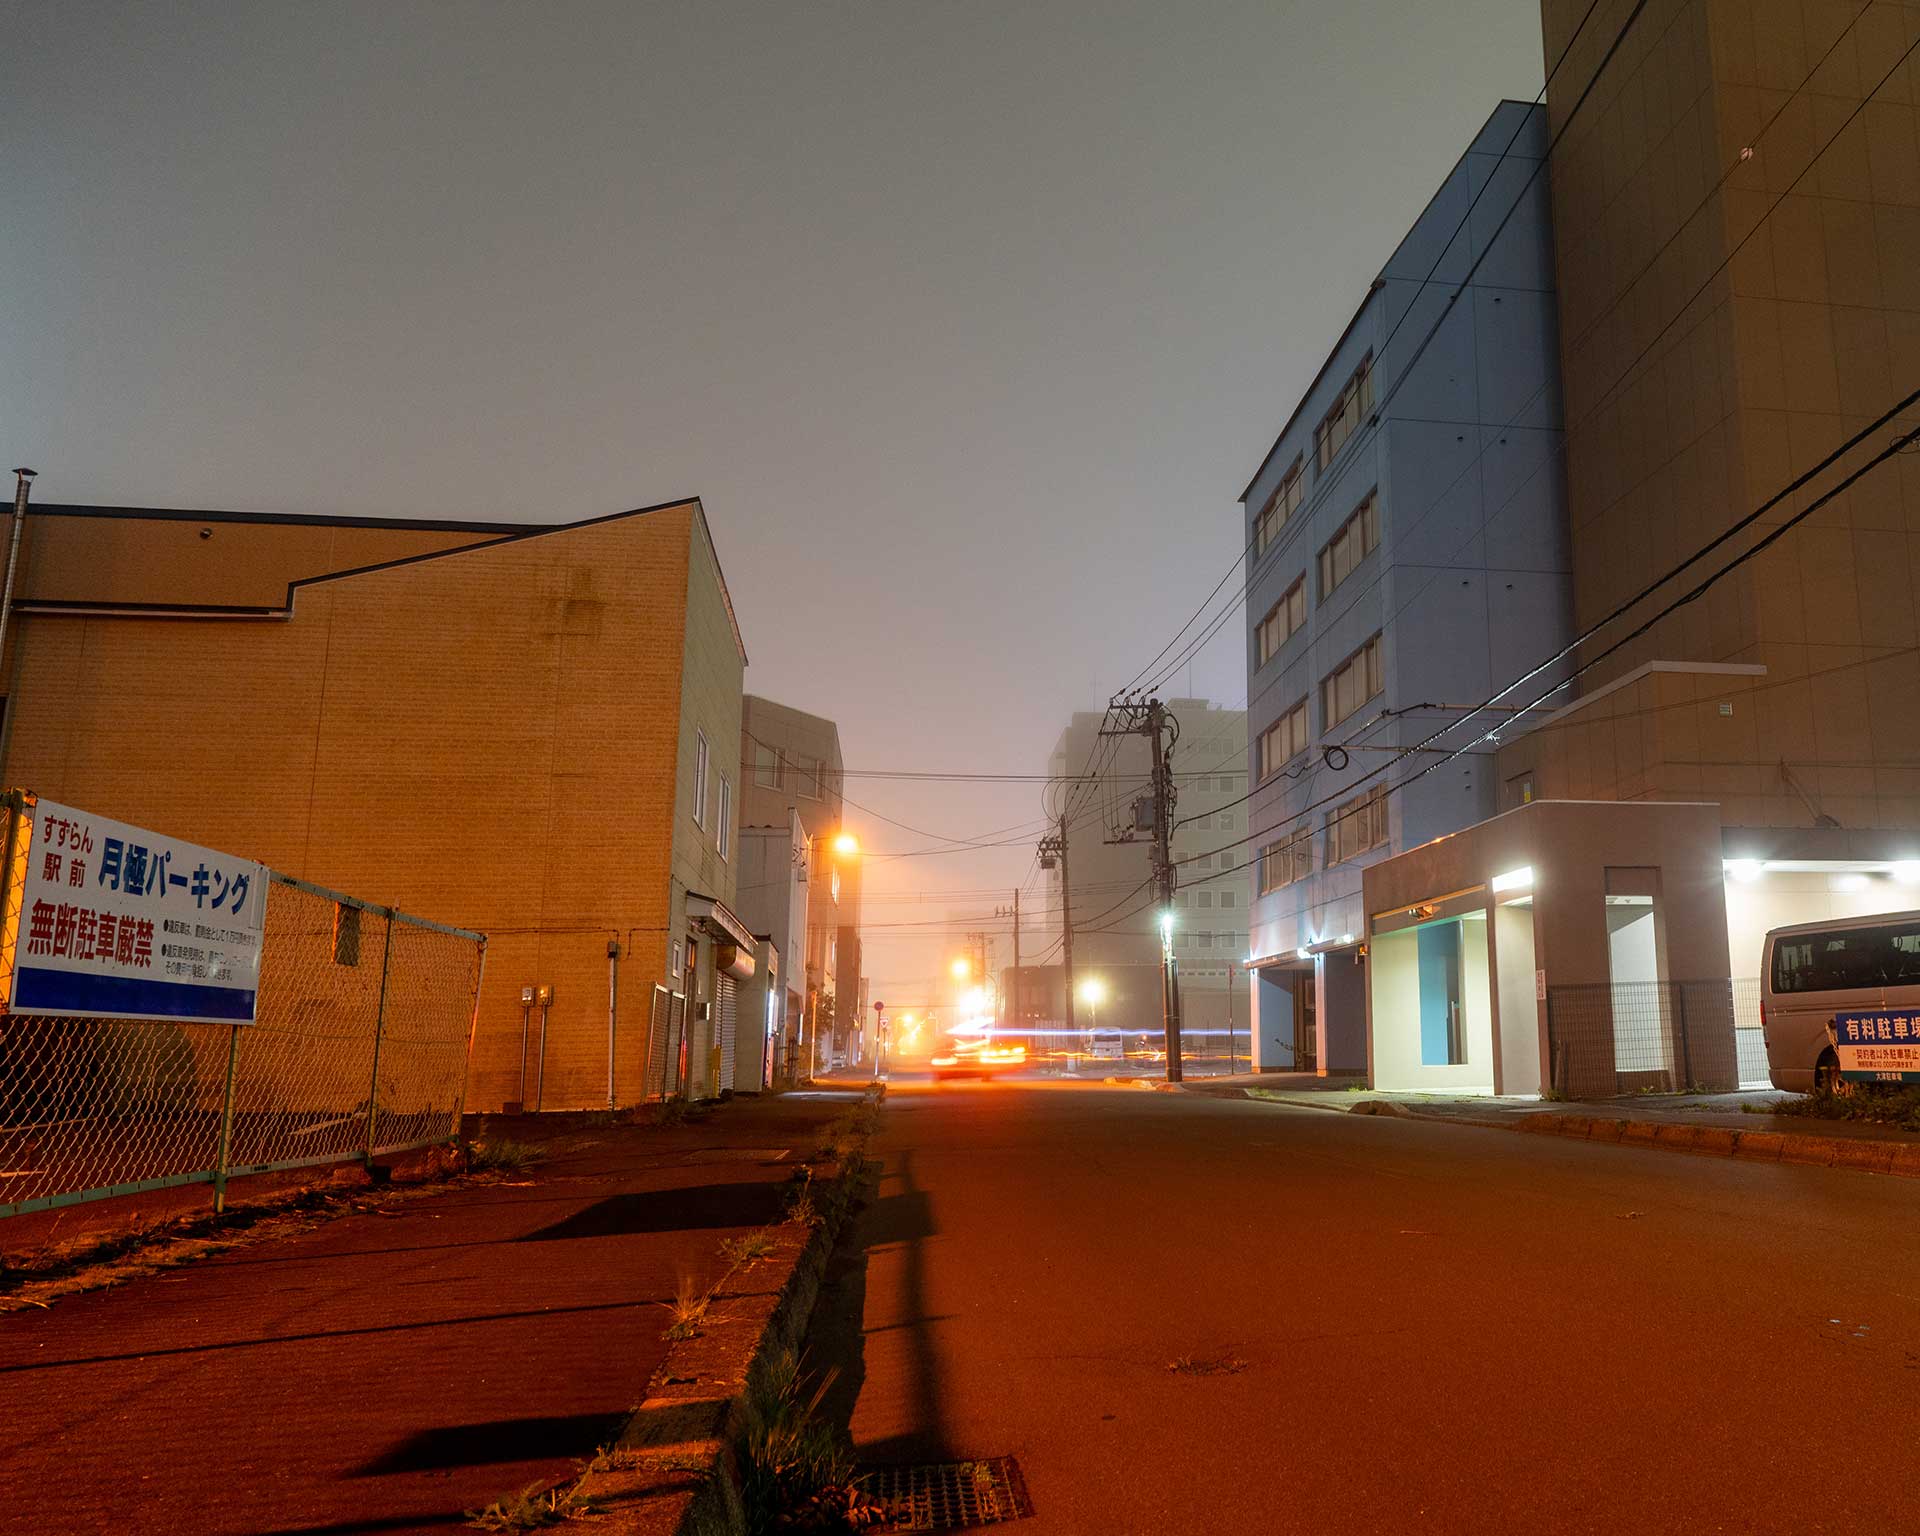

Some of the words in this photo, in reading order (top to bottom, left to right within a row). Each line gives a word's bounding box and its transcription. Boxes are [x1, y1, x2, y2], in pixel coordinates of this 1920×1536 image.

[43, 815, 94, 854] すずらん
[42, 852, 87, 888] 駅前
[98, 837, 250, 915] 月極パーキング
[27, 897, 155, 969] 無断駐車厳禁
[1845, 1016, 1920, 1041] 有料駐車場
[1856, 1047, 1919, 1060] 契約者以外駐車禁止
